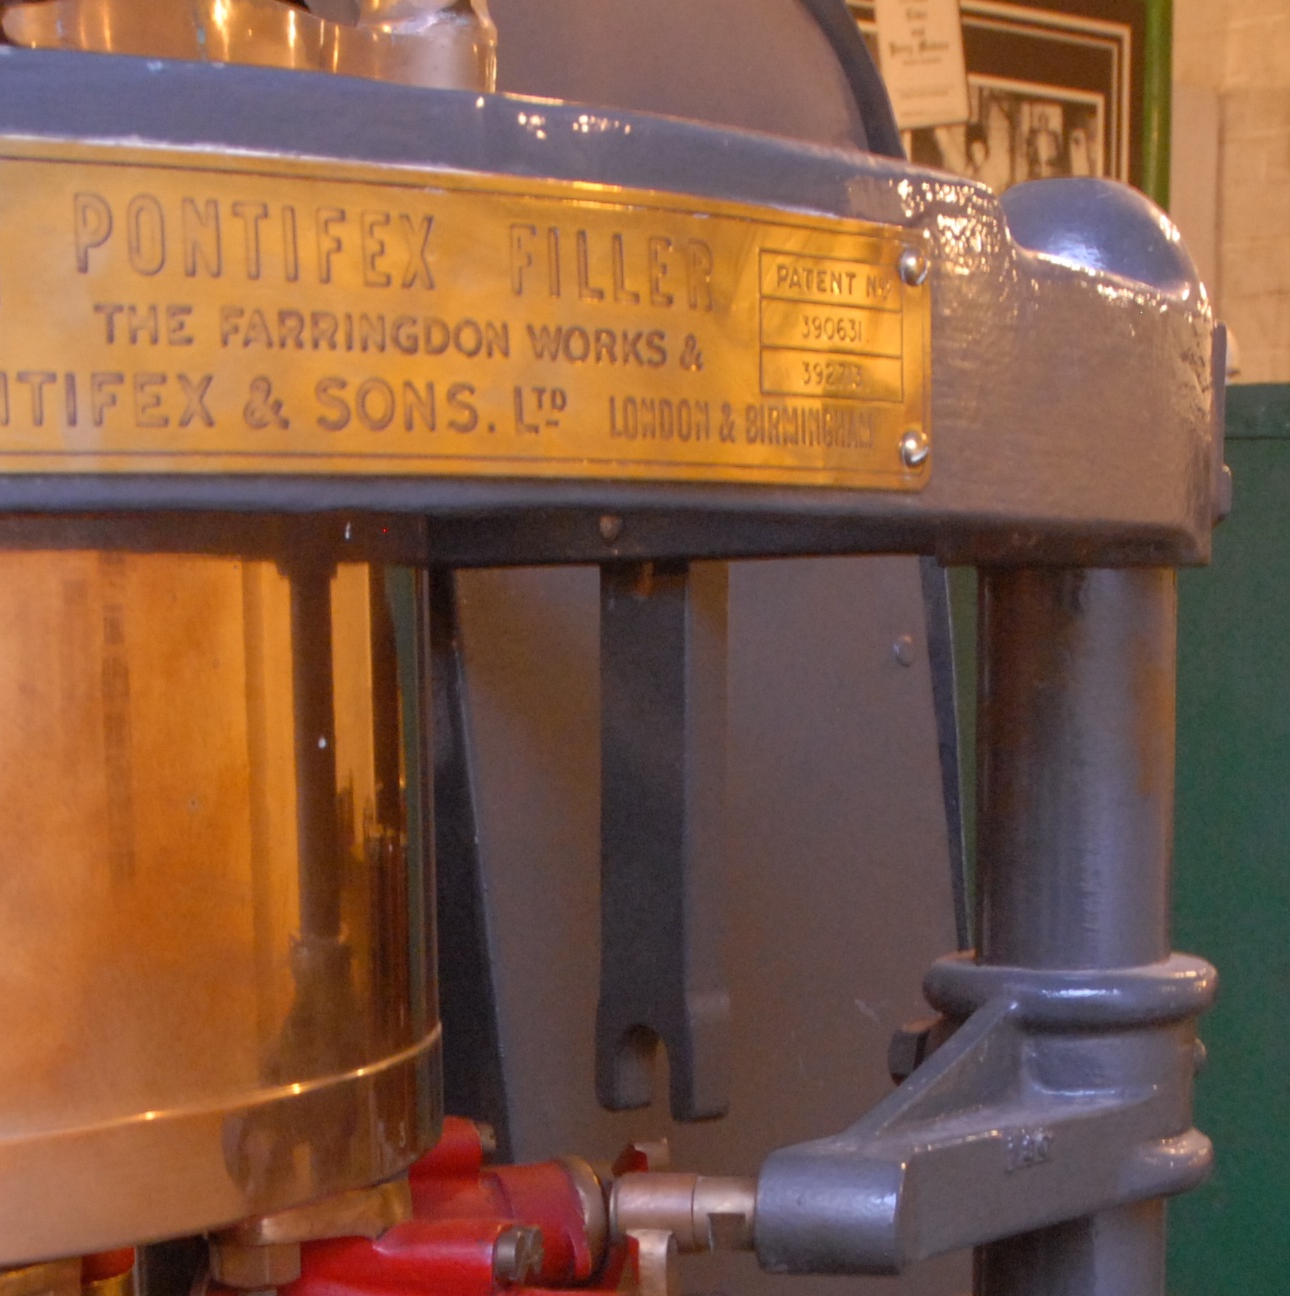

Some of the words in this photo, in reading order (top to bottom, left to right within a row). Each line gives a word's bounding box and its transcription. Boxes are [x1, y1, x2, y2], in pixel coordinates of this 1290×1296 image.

[71, 191, 437, 291] PONTIFEX
[509, 222, 714, 314] FILLER
[775, 263, 857, 296] PATENT
[92, 303, 194, 347] THE
[219, 306, 510, 358] FARRINGDON
[525, 323, 668, 368] WORKS
[679, 332, 704, 372] &
[801, 314, 862, 344] 390631
[242, 373, 290, 431] &
[313, 375, 496, 434] SONS.
[608, 394, 710, 443] LONDON
[720, 402, 737, 444] &
[745, 404, 876, 450] BIRMINGHAM
